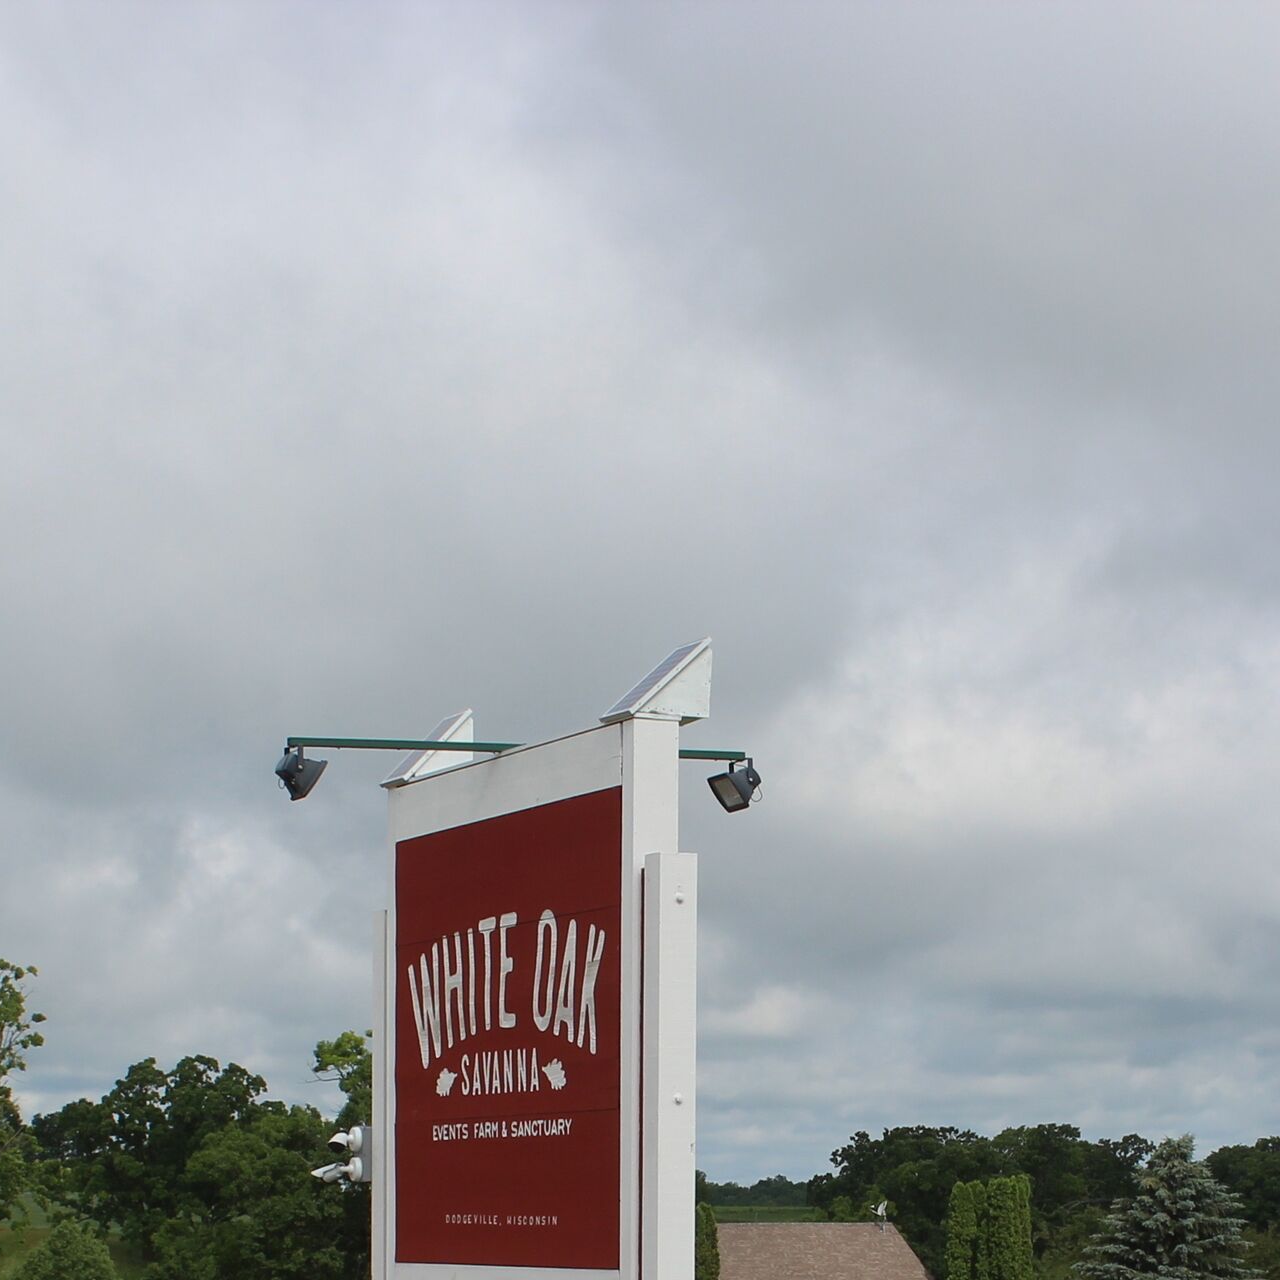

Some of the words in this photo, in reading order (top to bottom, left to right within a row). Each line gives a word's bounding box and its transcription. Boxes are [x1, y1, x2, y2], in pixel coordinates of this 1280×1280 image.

[408, 911, 517, 1070] WHITE
[532, 909, 606, 1056] OAK
[461, 1047, 539, 1096] SAVANNA
[432, 1123, 469, 1142] EVENTS
[474, 1121, 499, 1139] FARM
[501, 1120, 508, 1138] &
[511, 1118, 573, 1138] SANCTUARY
[445, 1213, 502, 1227] DODGEVILLE,
[506, 1215, 558, 1226] WISCONSIN
